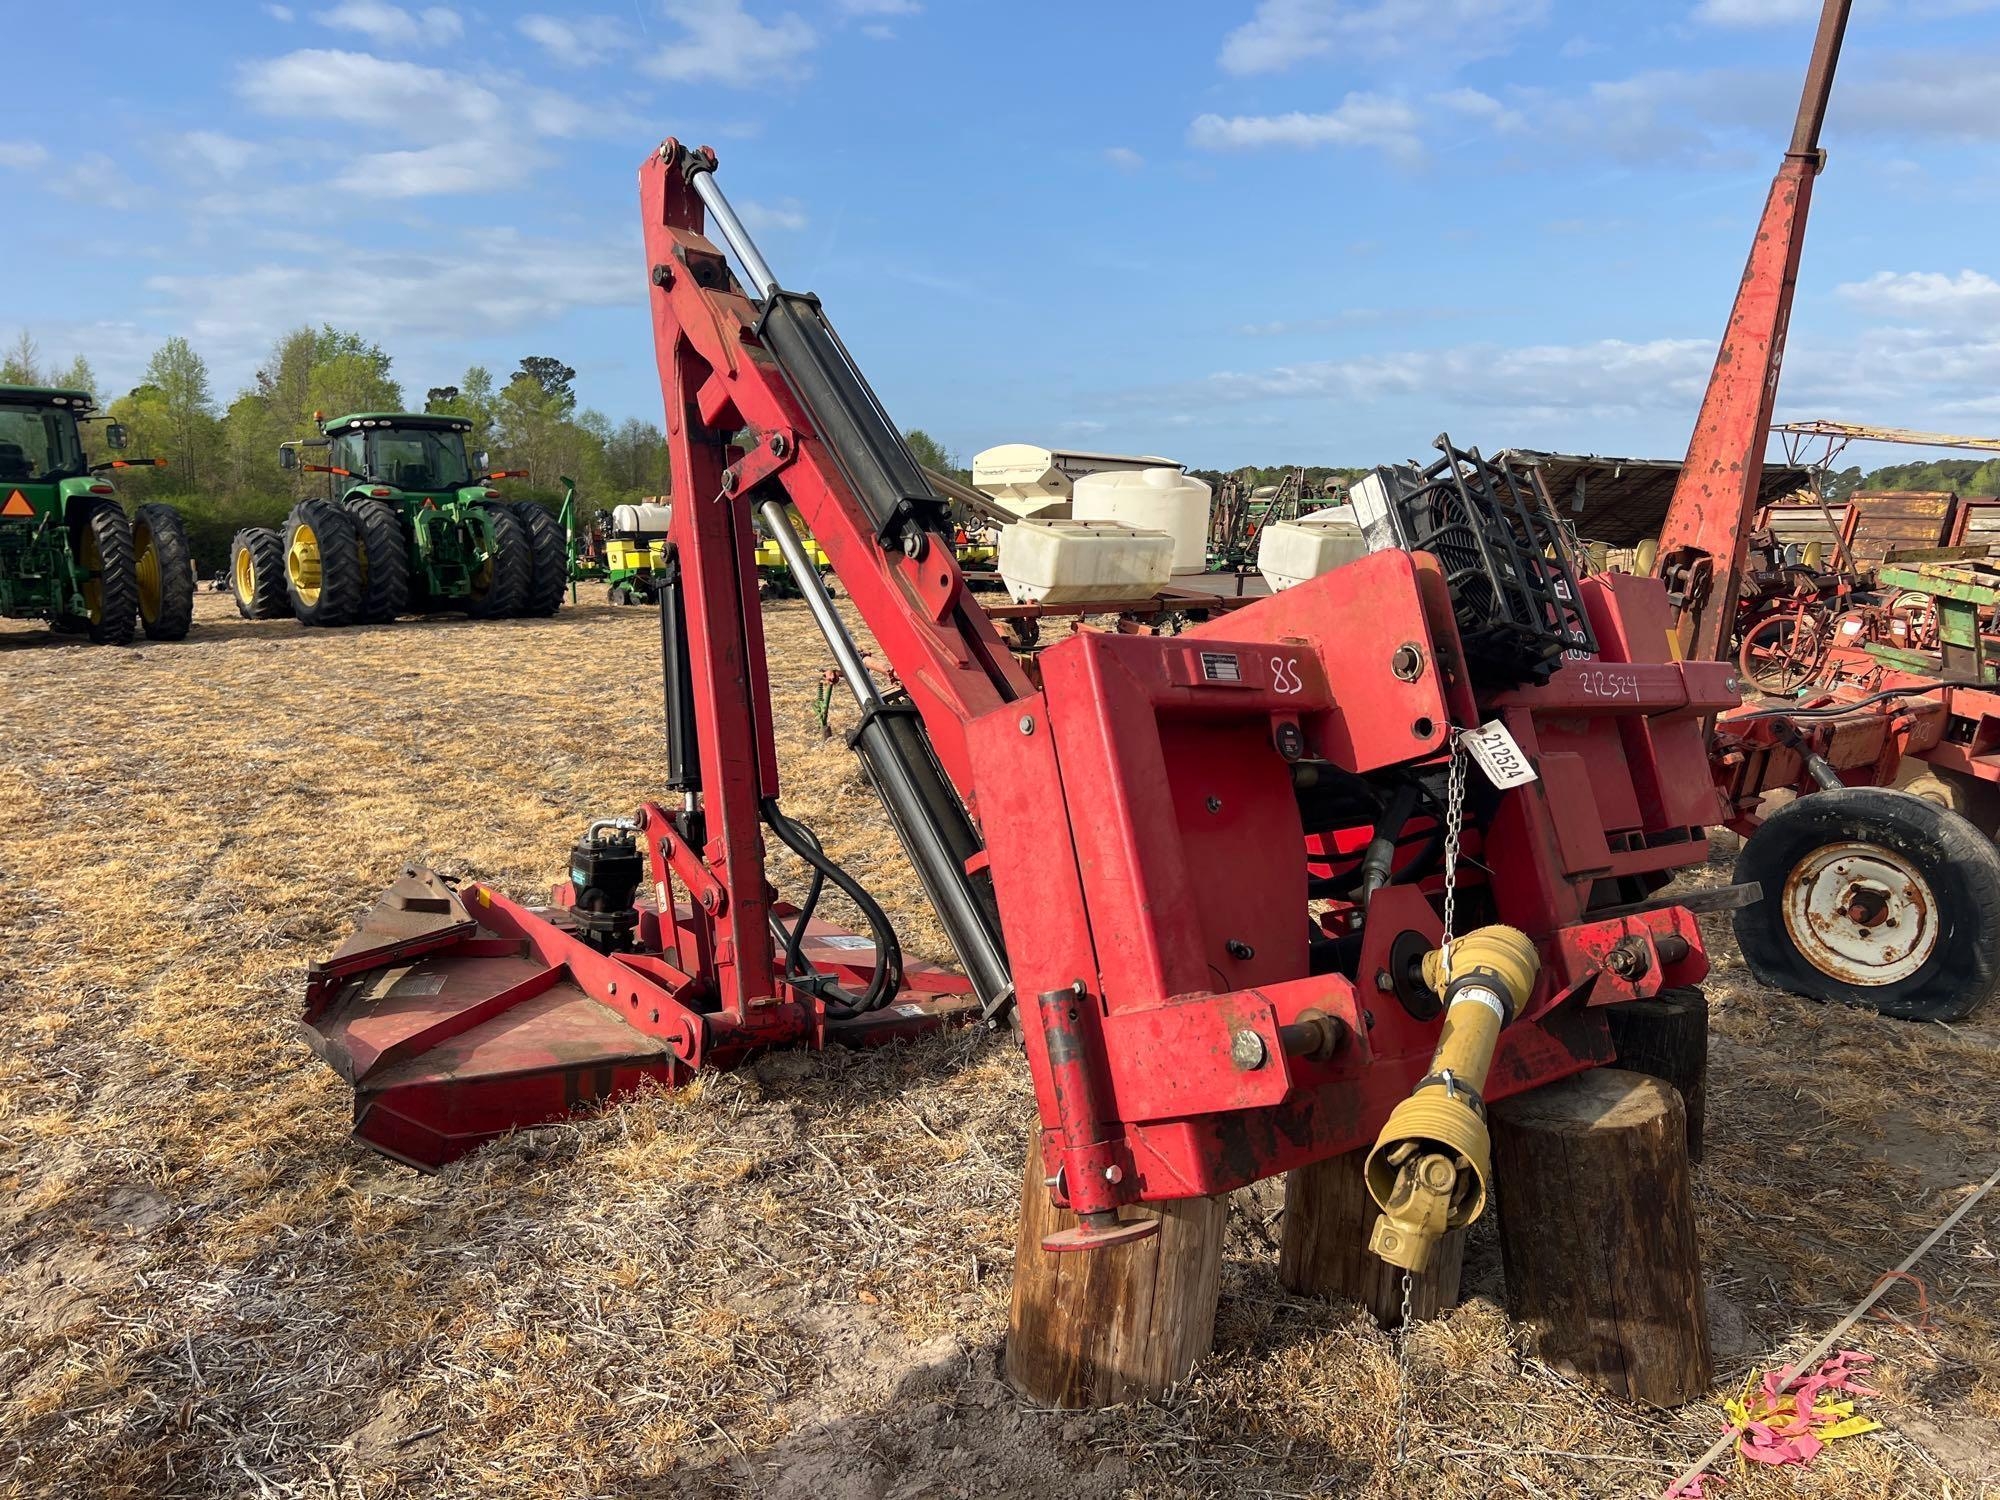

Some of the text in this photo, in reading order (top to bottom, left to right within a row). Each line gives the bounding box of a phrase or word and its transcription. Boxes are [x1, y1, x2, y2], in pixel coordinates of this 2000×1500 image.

[1270, 656, 1303, 695] 85
[1579, 671, 1640, 702] 212524
[1482, 733, 1525, 779] 212524
